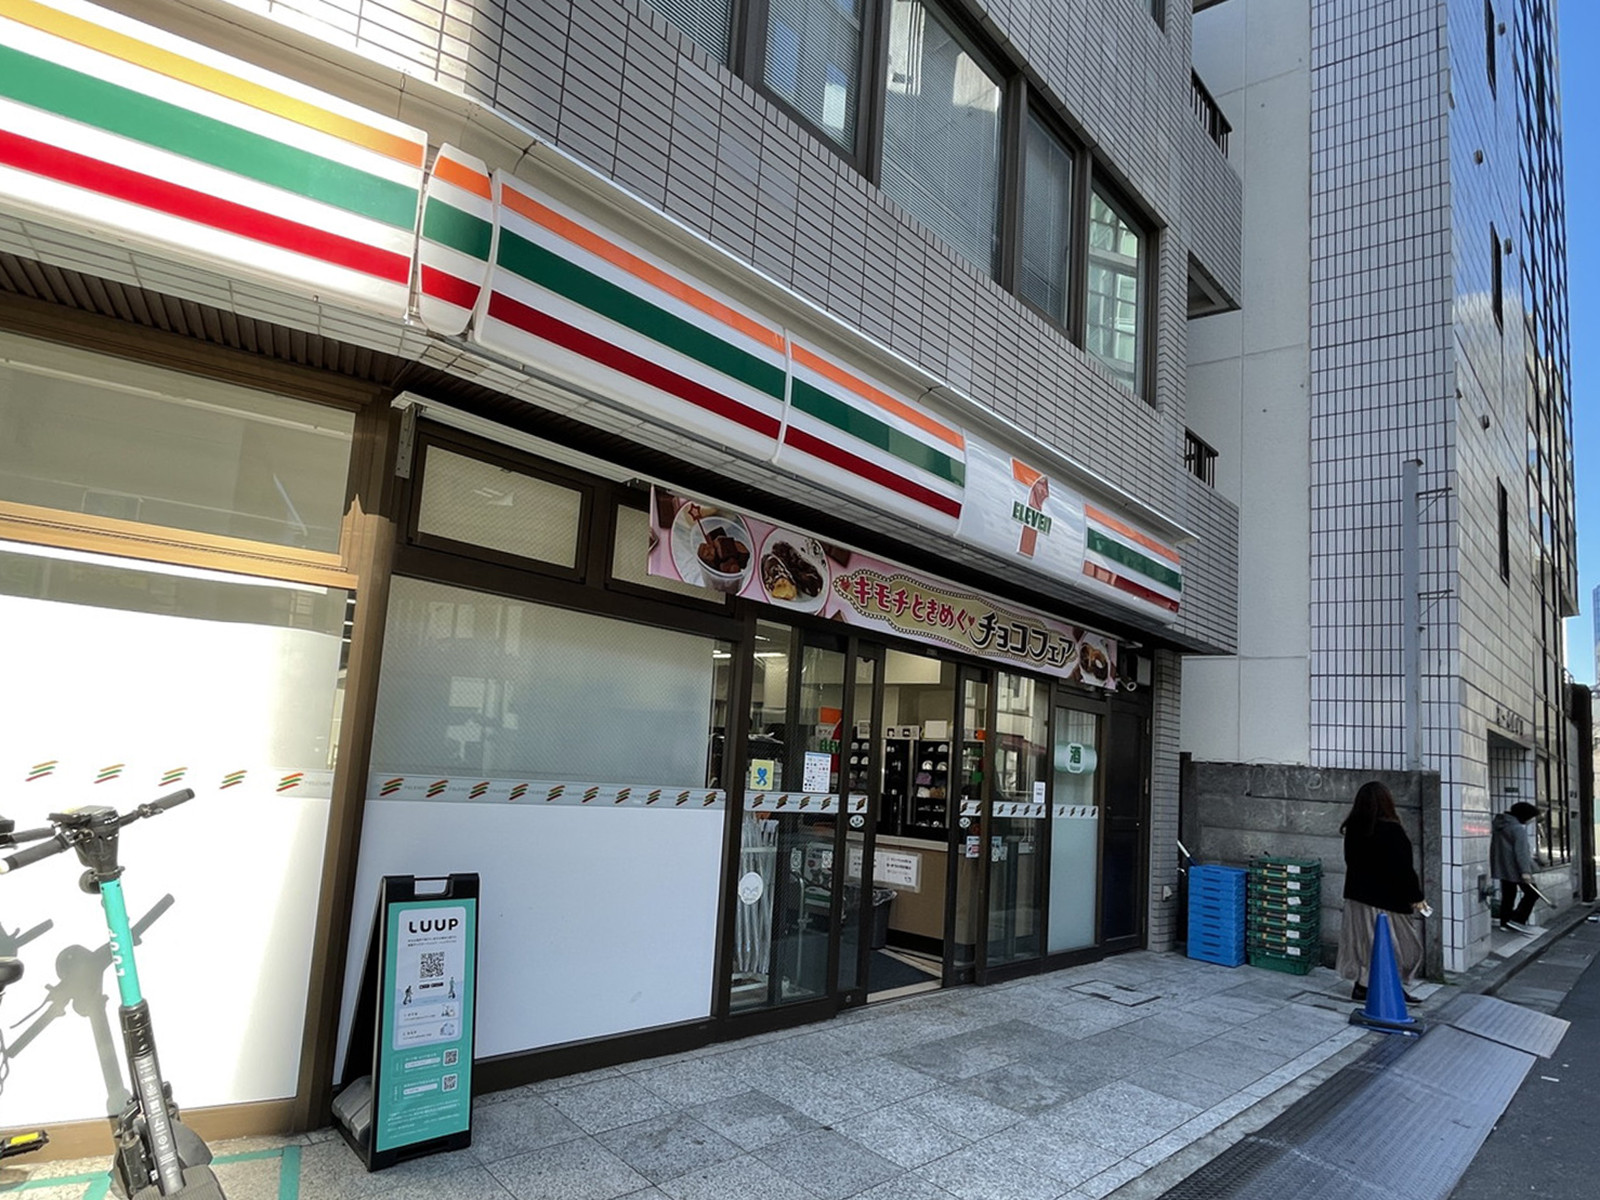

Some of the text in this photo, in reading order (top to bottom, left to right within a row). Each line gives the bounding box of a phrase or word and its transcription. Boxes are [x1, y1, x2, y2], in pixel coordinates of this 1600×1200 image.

[853, 577, 1075, 664] キモチときめく チョコフェア
[1069, 745, 1082, 764] 酒
[409, 918, 459, 934] LUUP
